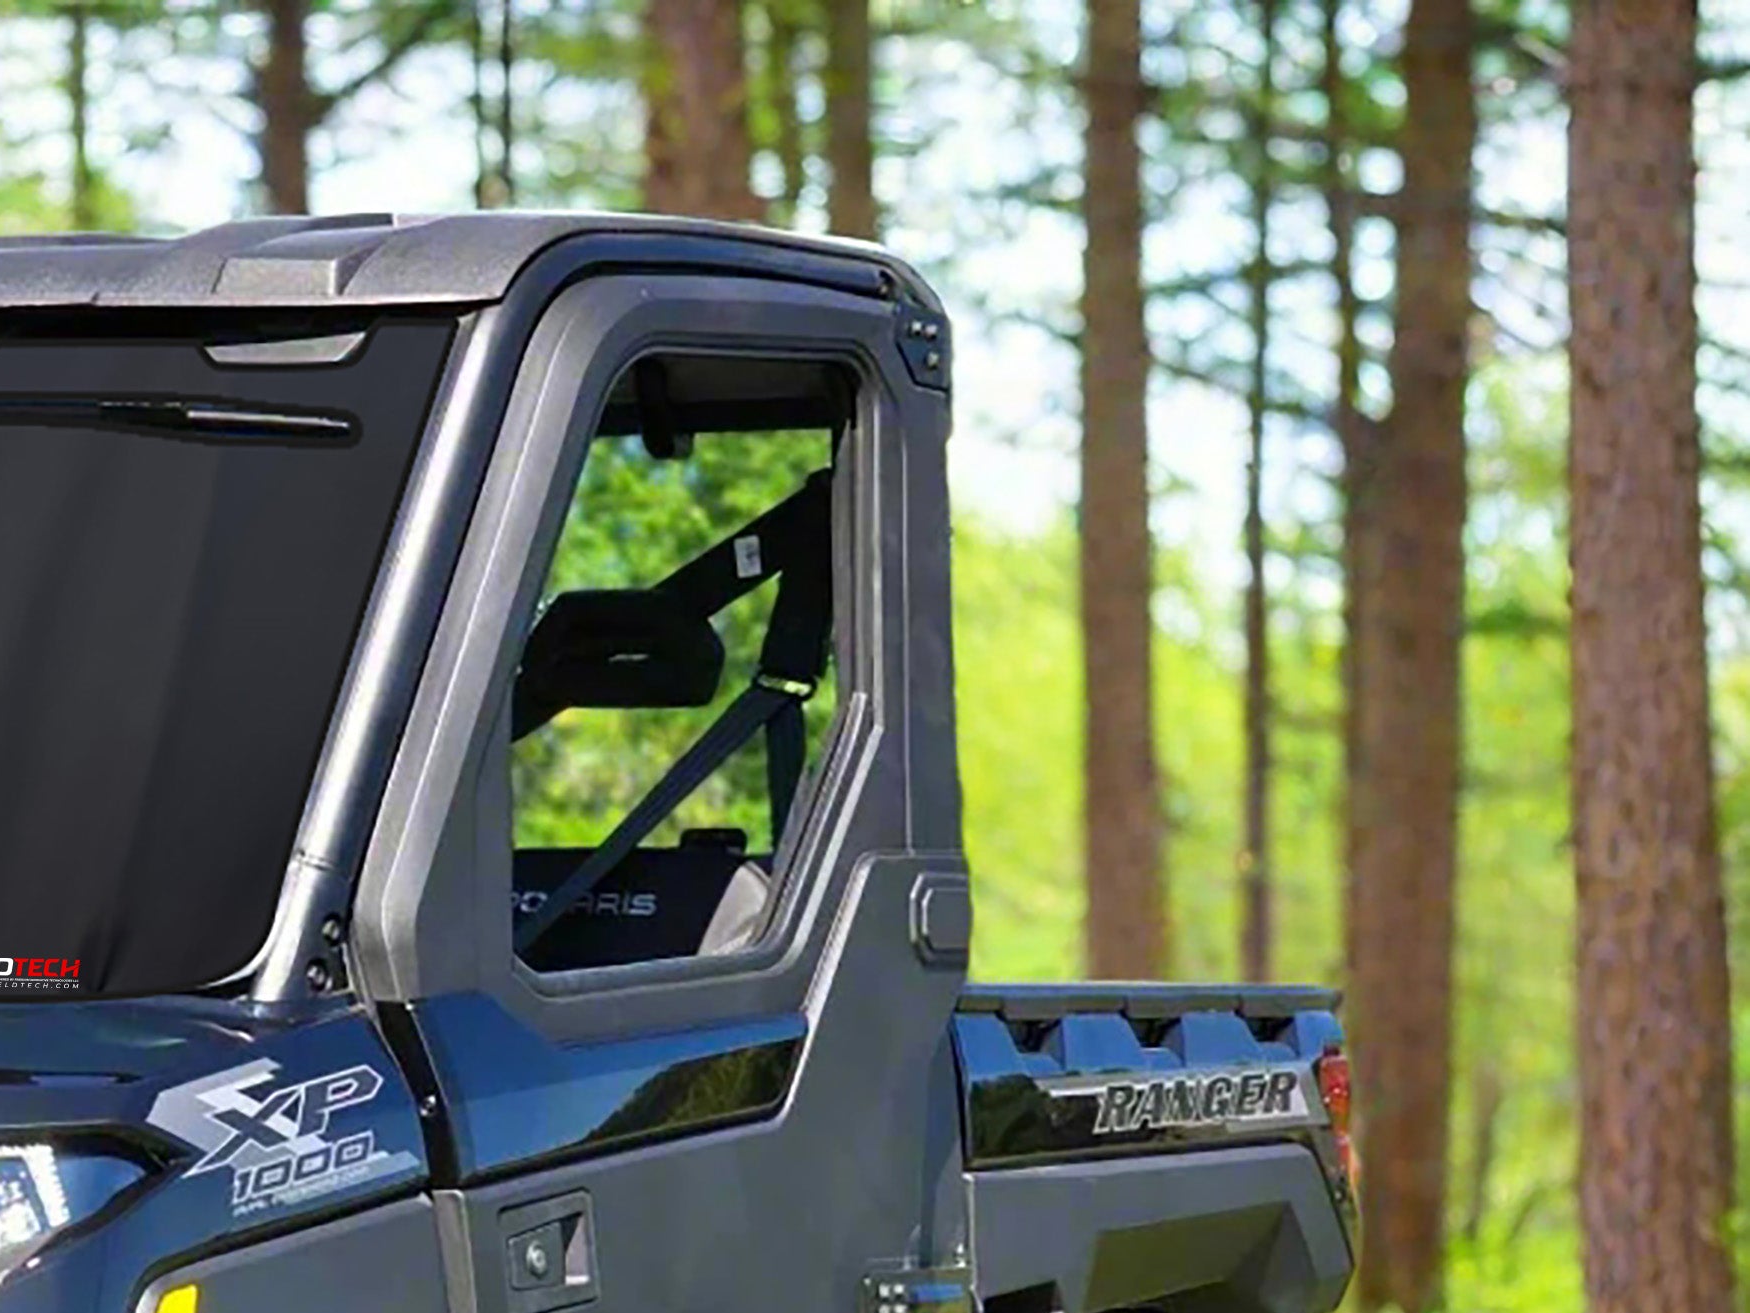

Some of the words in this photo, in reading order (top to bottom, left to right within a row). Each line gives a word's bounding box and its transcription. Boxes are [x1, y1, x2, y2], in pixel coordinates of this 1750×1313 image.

[511, 891, 658, 917] OARIS
[180, 1063, 385, 1179] XP
[1092, 1070, 1299, 1134] RANGER
[234, 1130, 374, 1202] 1000
